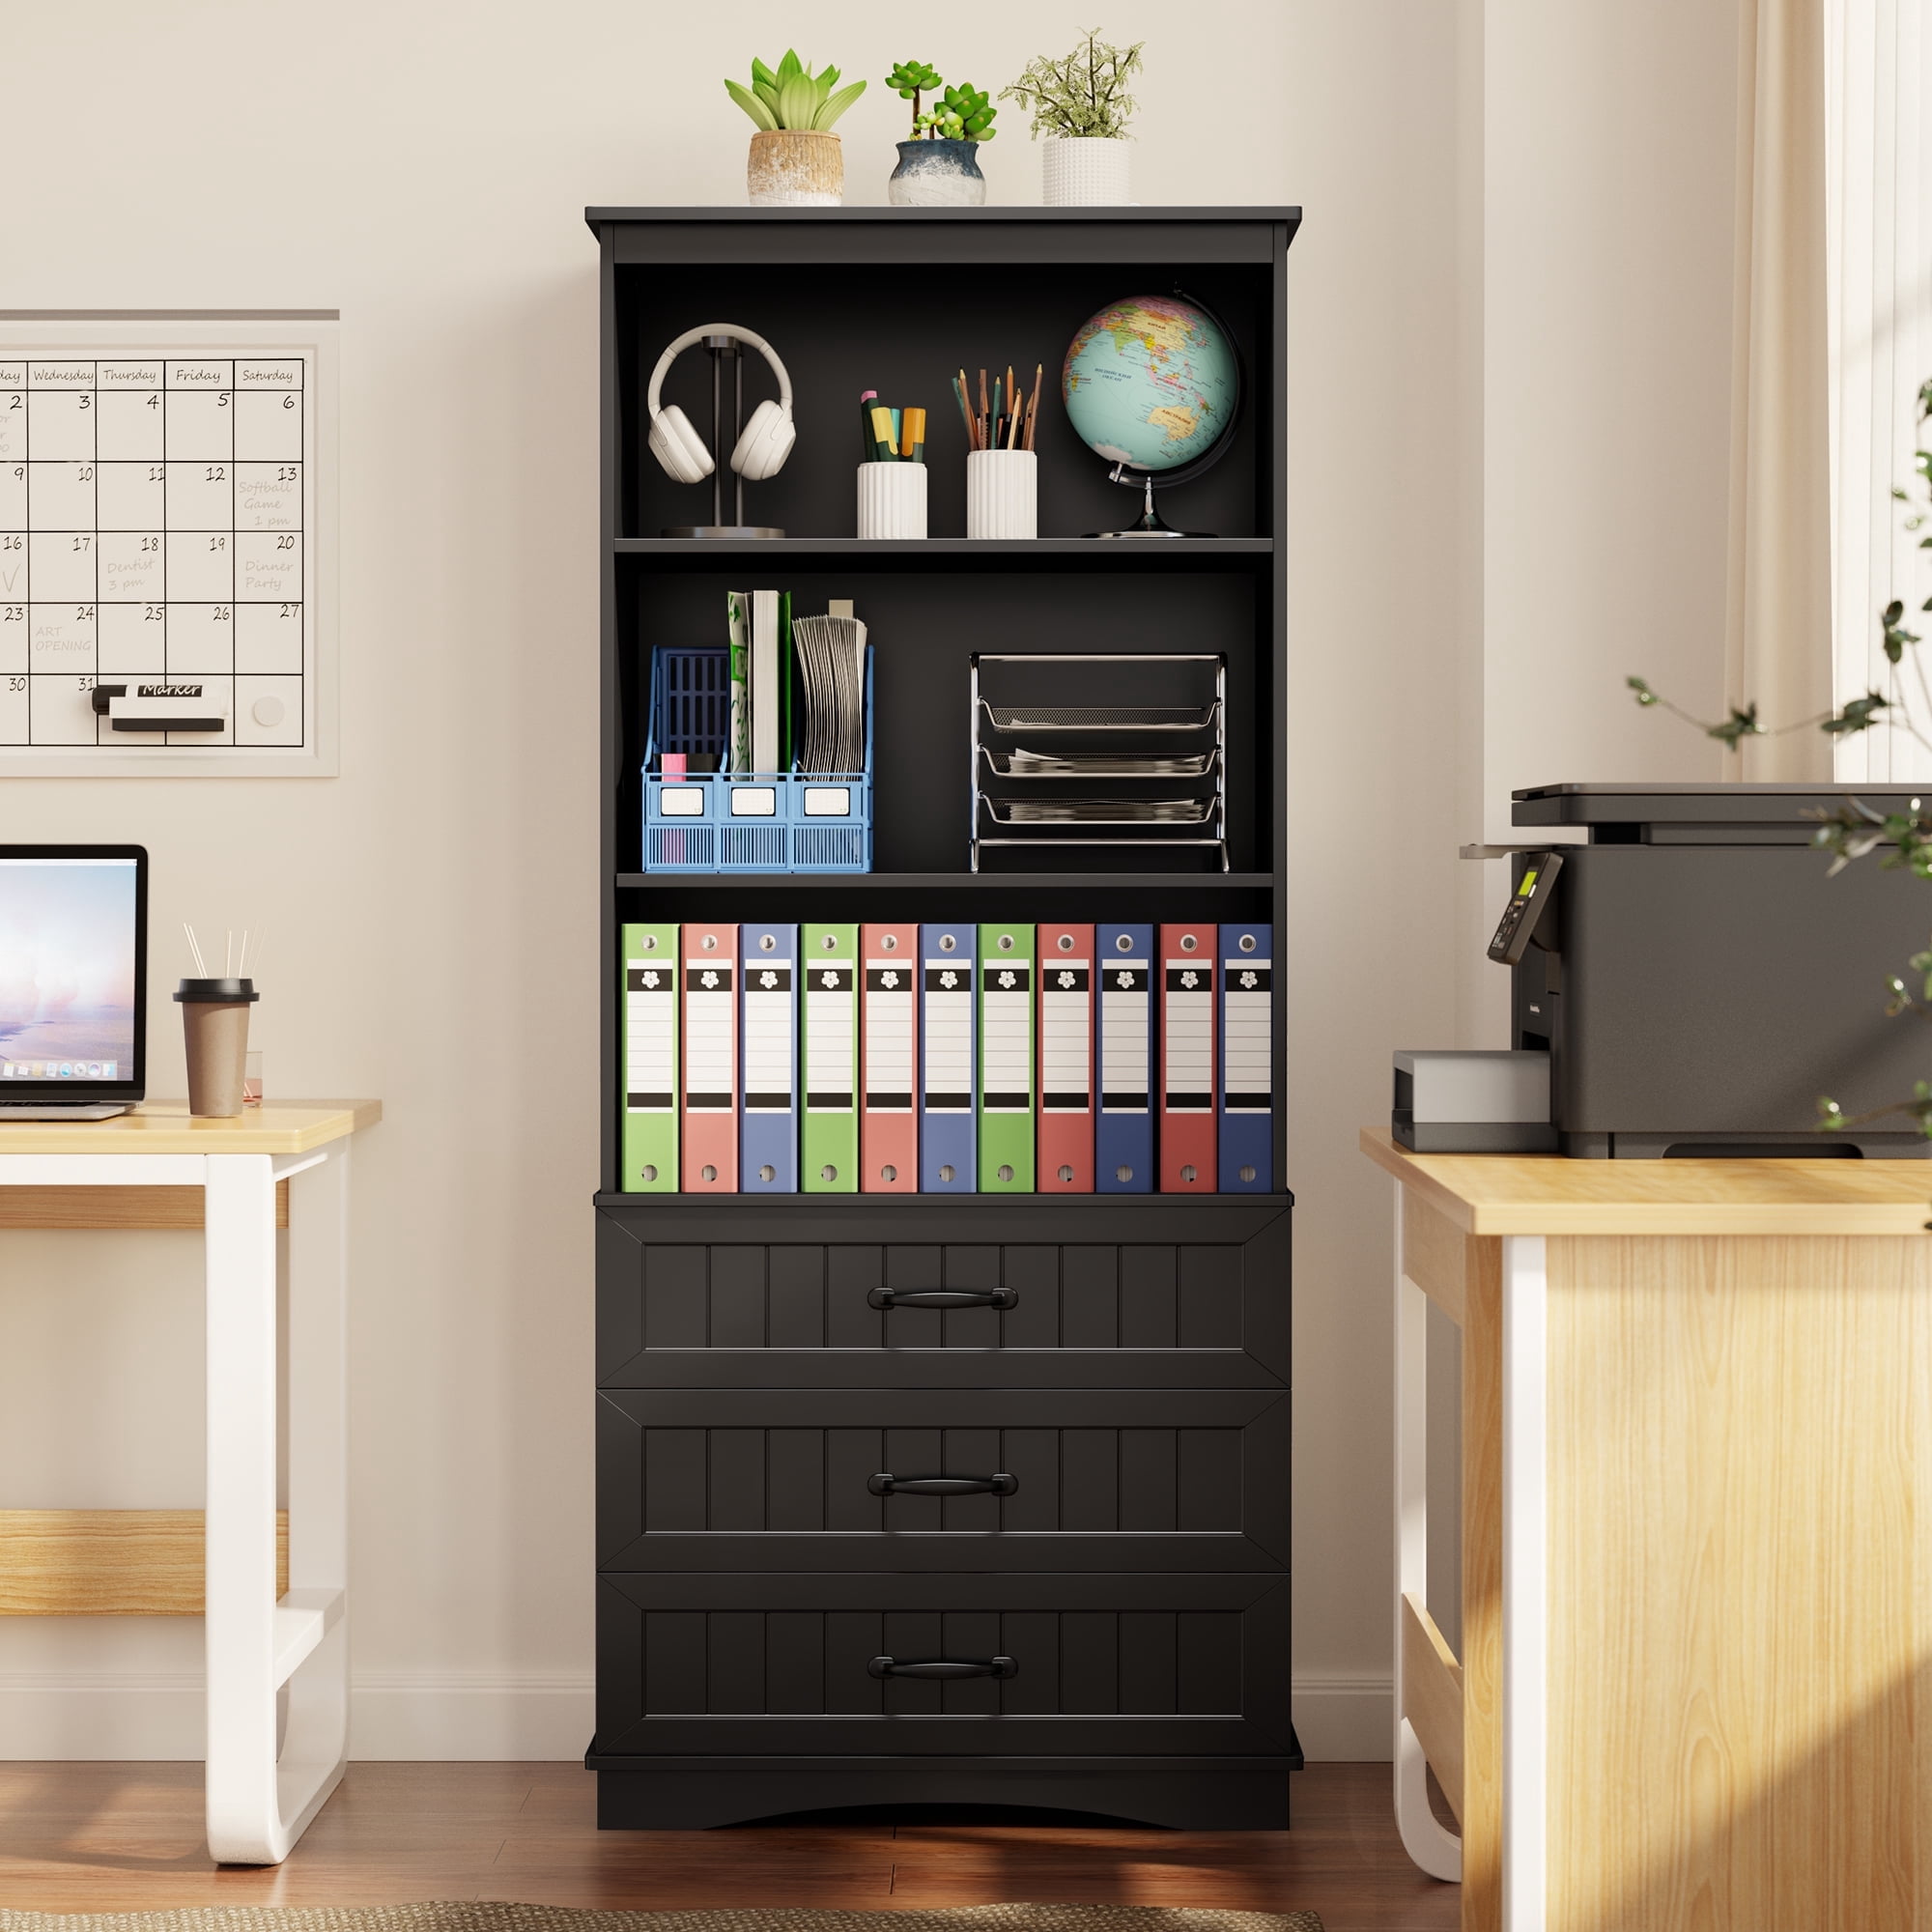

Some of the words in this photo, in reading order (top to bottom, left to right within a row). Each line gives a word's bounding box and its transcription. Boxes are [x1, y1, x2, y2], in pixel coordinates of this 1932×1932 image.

[33, 368, 95, 384] Wednesday
[103, 369, 156, 384] Thursday
[176, 368, 221, 384] Friday
[242, 368, 294, 384] Saturday
[10, 394, 22, 411] 2
[78, 395, 91, 410] 3
[147, 394, 159, 410] 4
[217, 392, 231, 408] 5
[283, 395, 295, 410] 6
[14, 467, 24, 481] 9
[78, 467, 93, 481] 10
[149, 467, 165, 481] 11
[206, 467, 226, 481] 12
[277, 467, 298, 481] 13
[239, 481, 293, 497] Softball
[243, 497, 282, 511] Game
[255, 515, 263, 526] 1
[268, 517, 291, 529] pm
[3, 536, 22, 551] 16
[72, 537, 91, 552] 17
[141, 537, 158, 552] 18
[209, 537, 225, 552] 19
[276, 535, 295, 551] 20
[107, 557, 156, 574] Dentist
[245, 559, 295, 573] Dinner
[108, 580, 117, 591] 3
[123, 579, 144, 593] pm
[245, 577, 282, 591] Party
[5, 607, 24, 621] 23
[76, 606, 95, 621] 24
[145, 607, 164, 621] 25
[213, 607, 230, 621] 26
[280, 604, 299, 618] 27
[35, 627, 62, 638] ART
[35, 639, 92, 652] OPENING
[9, 677, 26, 692] 30
[78, 677, 95, 692] 31
[142, 684, 201, 696] Marker
